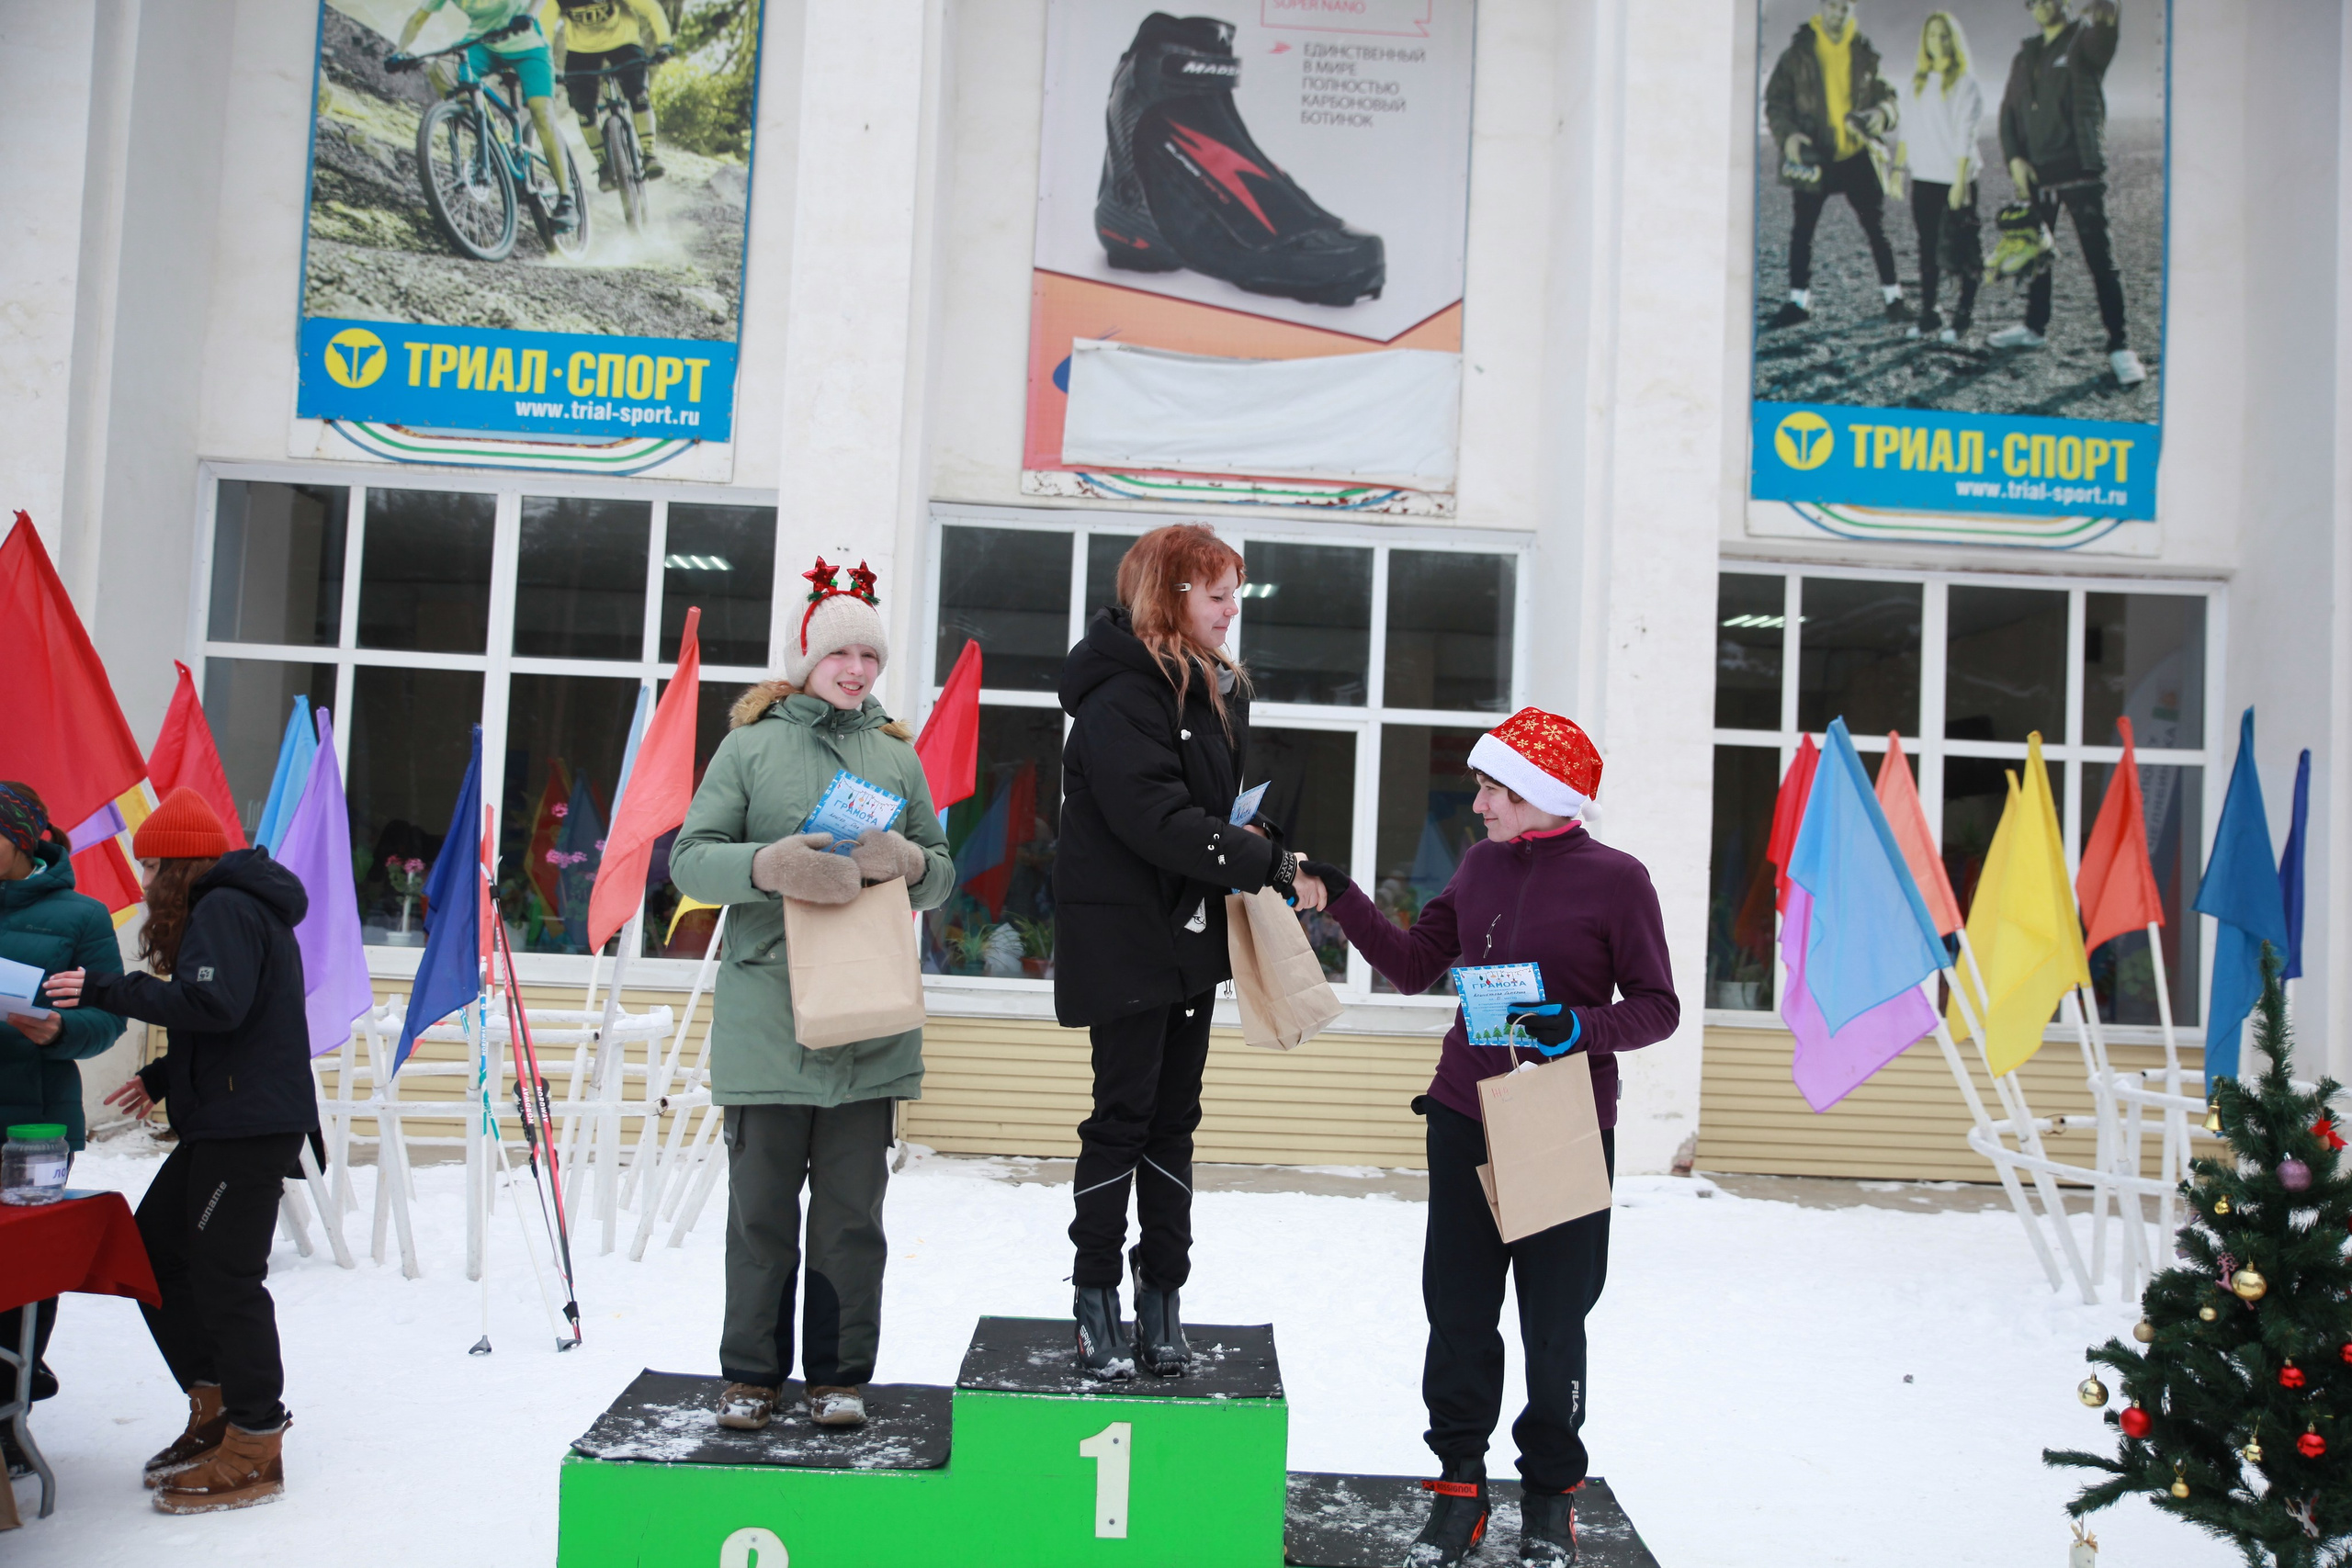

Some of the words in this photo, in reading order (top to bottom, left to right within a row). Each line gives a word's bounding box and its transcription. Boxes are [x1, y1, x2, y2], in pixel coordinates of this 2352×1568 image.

[1303, 42, 1426, 62] ЕДИНСТВЕННЫЙ
[1182, 61, 1240, 76] MADS
[1303, 61, 1312, 73] В
[1316, 62, 1357, 75] МИРЕ
[1302, 76, 1400, 96] ПОЛНОСТЬЮ
[1301, 95, 1407, 113] КАРБОНОВЫЙ
[1300, 110, 1374, 128] БОТИНОК
[515, 400, 700, 427] www.trial-sport.ru
[1955, 479, 2128, 506] www.trial-sport.ru
[2147, 726, 2177, 848] ЧЕЛЯБИНКА
[833, 799, 878, 826] ГРАМОТА
[1472, 980, 1527, 989] ГРАМОТА
[522, 1087, 535, 1124] NORDWAY
[537, 1086, 548, 1122] NORDWAY
[198, 1181, 228, 1231] noname
[1080, 1325, 1095, 1358] SPINE
[1571, 1380, 1579, 1413] FILA
[1080, 1422, 1132, 1539] 1
